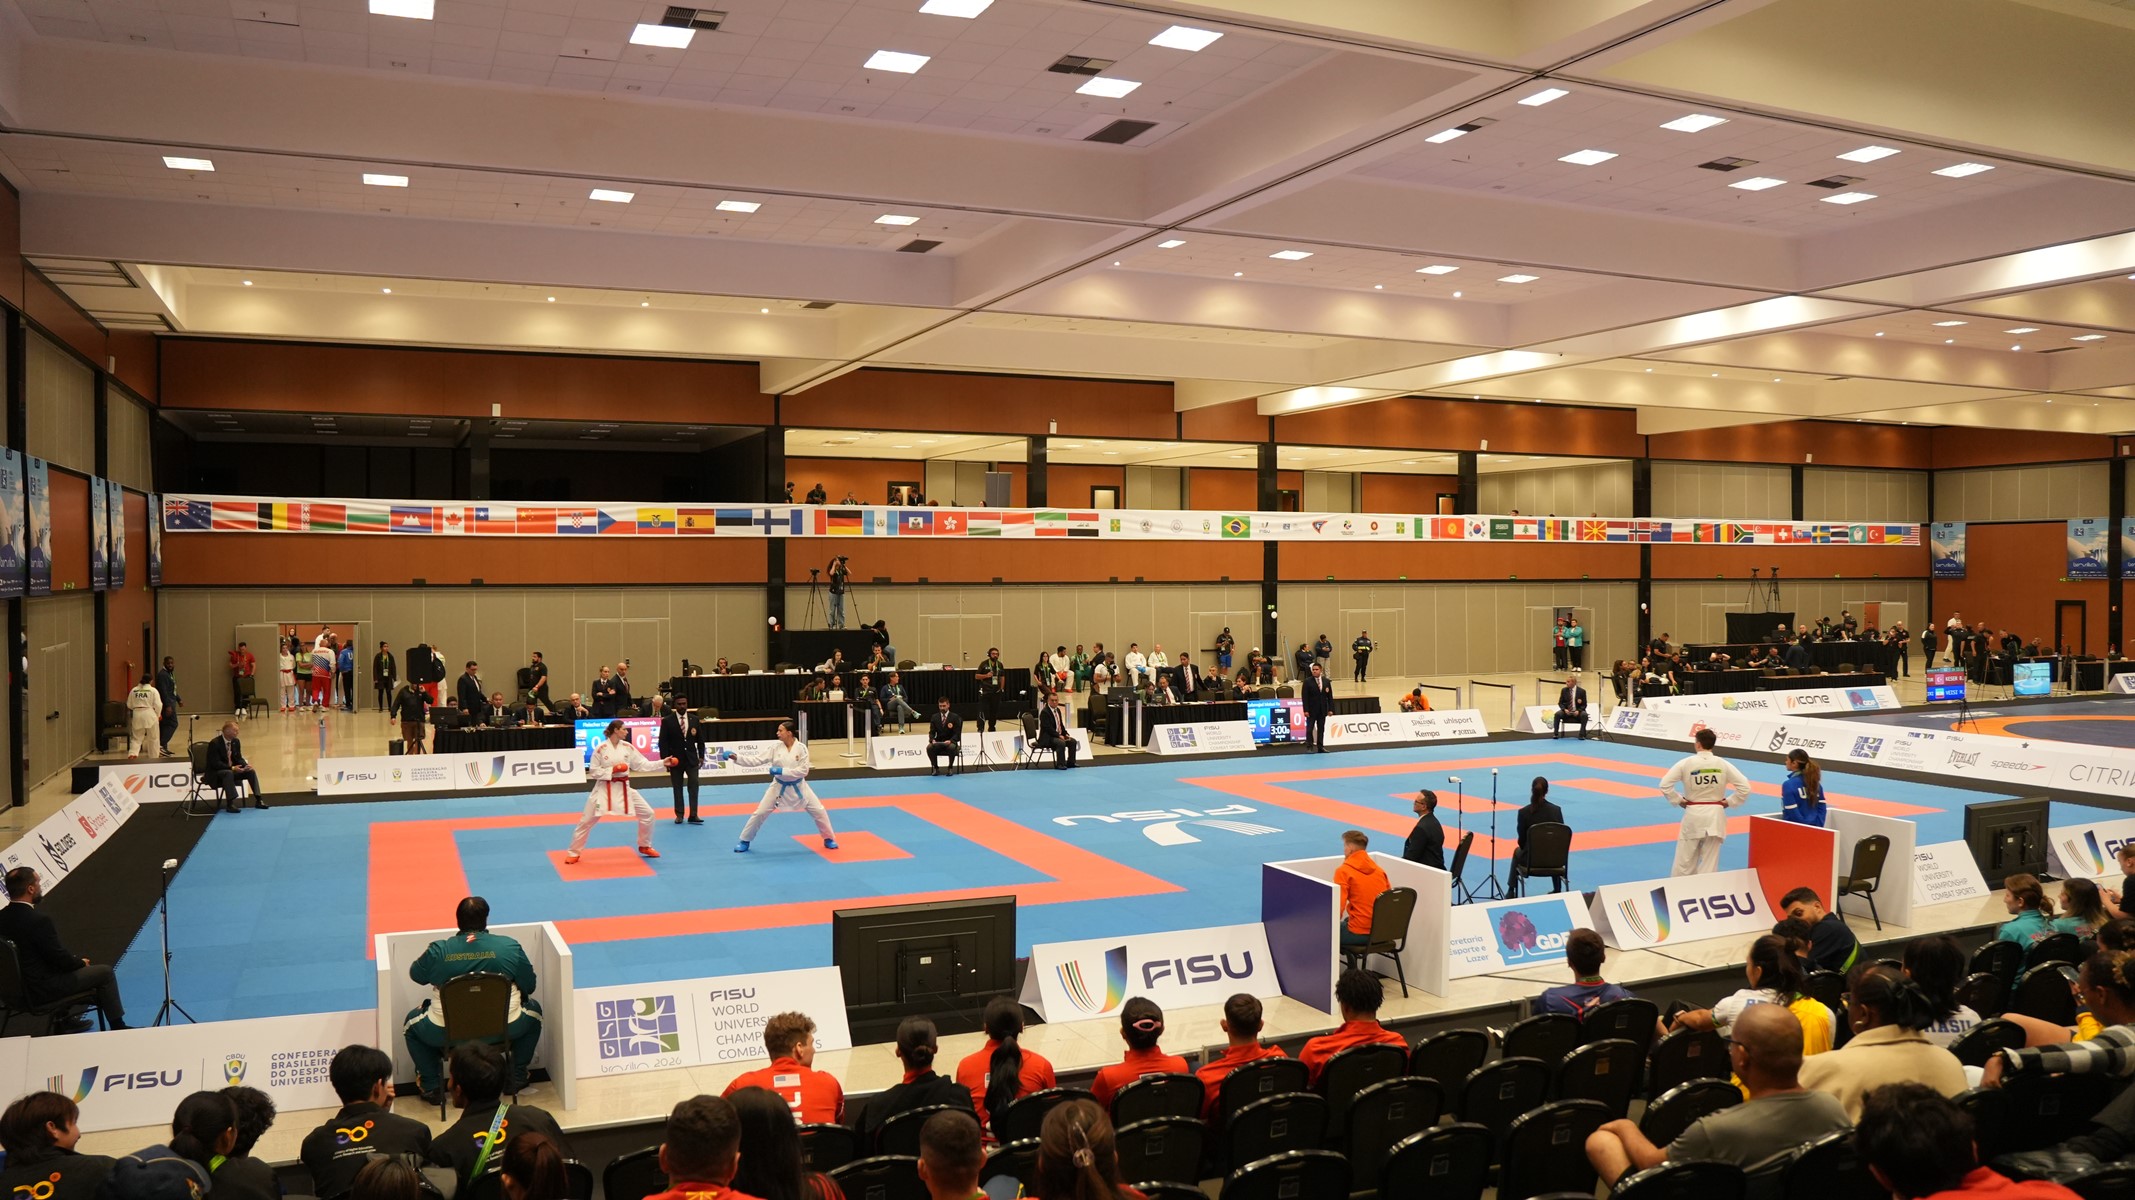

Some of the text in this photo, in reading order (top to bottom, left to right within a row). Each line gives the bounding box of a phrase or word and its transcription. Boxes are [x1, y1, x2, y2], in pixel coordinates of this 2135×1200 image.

[1736, 700, 1769, 710] CONFAE
[1259, 715, 1267, 727] 0
[1293, 713, 1301, 726] 0
[1443, 716, 1473, 726] uhlsport
[1414, 730, 1440, 738] Kempa
[636, 734, 646, 749] 0
[1786, 737, 1827, 749] SOLDIERS
[1947, 749, 1981, 767] EVERLAST
[511, 760, 575, 777] FISU
[1990, 760, 2029, 771] speedo
[149, 773, 190, 788] ICO
[346, 773, 377, 781] FISU
[1695, 775, 1719, 785] USA
[1917, 862, 1939, 872] WORLD
[1921, 870, 1954, 882] UNIVERSITY
[1926, 877, 1968, 891] CHAMPIONSHIP
[1930, 886, 1977, 901] COMBAT SPORTS
[1677, 891, 1756, 923] FISU
[1450, 935, 1484, 946] cretaria
[445, 951, 496, 962] AUSTRALIA
[1466, 954, 1489, 963] Lazer
[1141, 950, 1254, 990] FISU
[710, 987, 756, 1002] FISU
[712, 1003, 760, 1016] WORLD
[714, 1016, 774, 1031] UNIVERS
[225, 1053, 246, 1061] CBDU
[271, 1049, 337, 1061] CONFEDERA
[718, 1045, 767, 1060] COMBA
[654, 1056, 682, 1068] 2026
[271, 1067, 328, 1078] DO DESPO
[103, 1069, 183, 1092] FISU
[271, 1075, 330, 1087] UNIVERSIT
